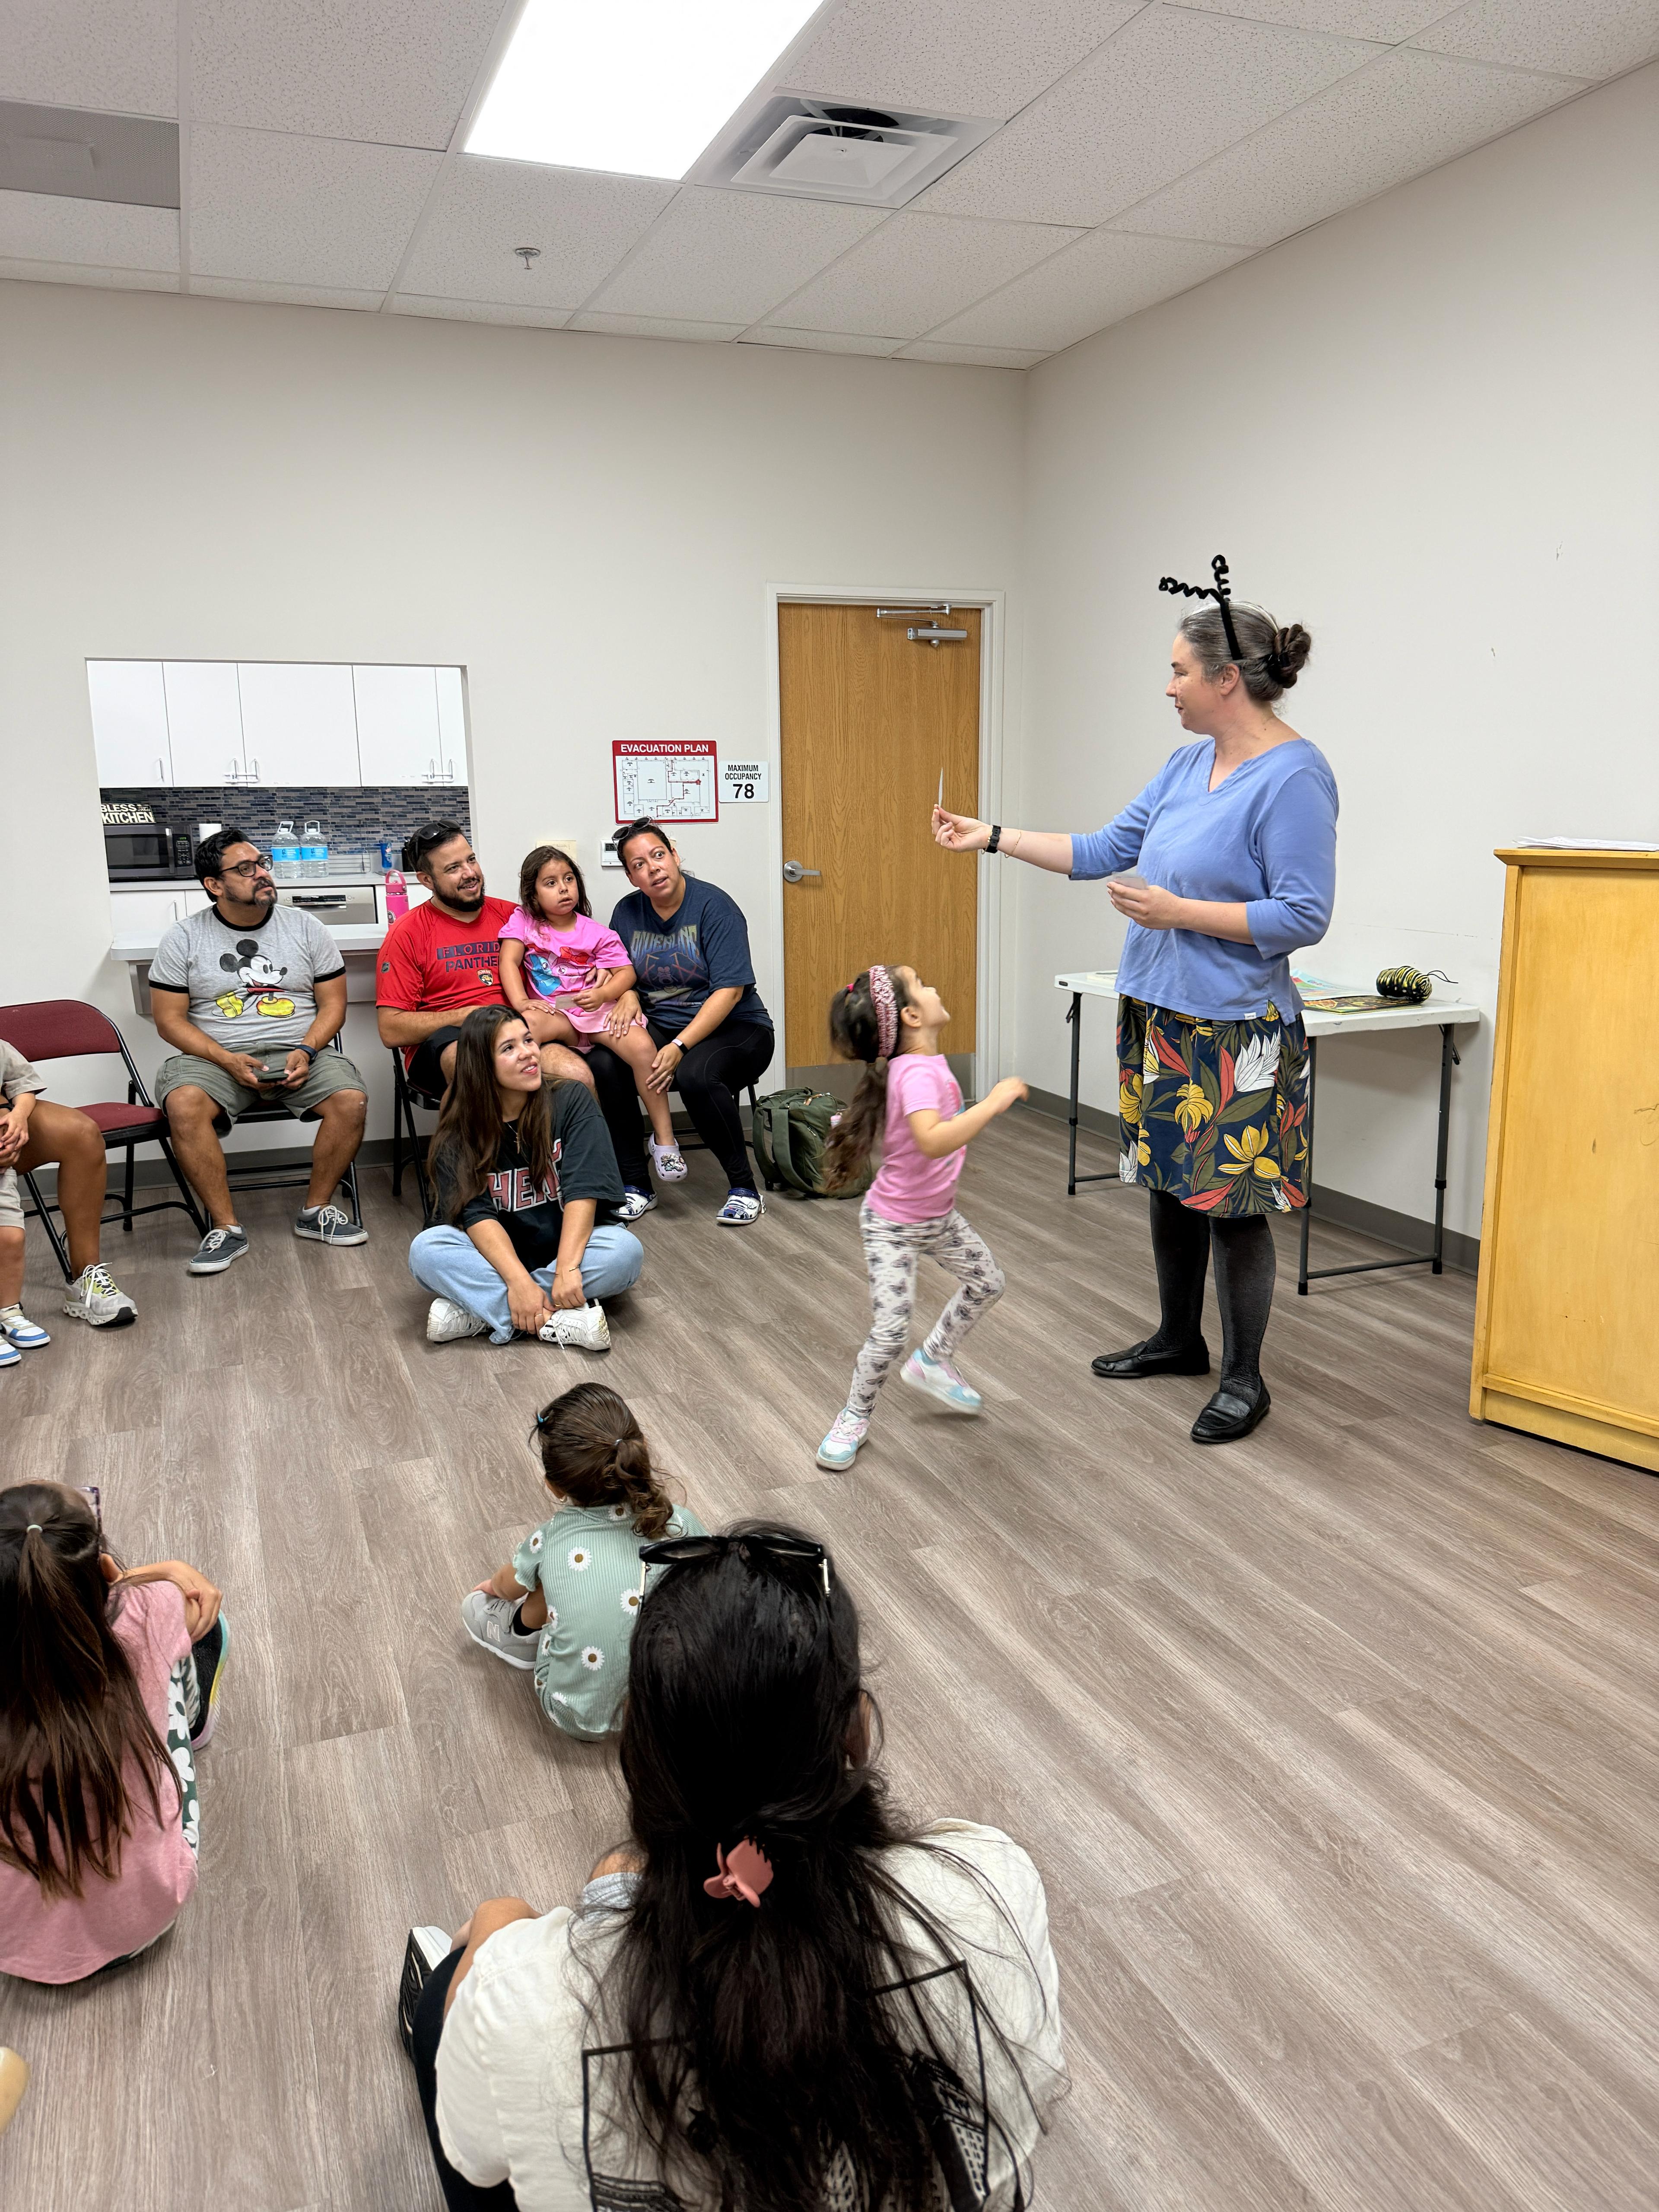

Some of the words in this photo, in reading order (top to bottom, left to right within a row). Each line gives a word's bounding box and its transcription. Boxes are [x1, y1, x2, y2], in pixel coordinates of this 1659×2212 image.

[620, 744, 682, 753] EVACUATION
[684, 744, 709, 753] PLAN
[733, 783, 755, 799] 78
[101, 804, 137, 812] BLESS
[102, 812, 155, 823] KITCHEN
[442, 942, 500, 958] FLORID
[445, 955, 498, 973] PANTHE
[487, 1138, 564, 1212] HEA
[487, 1620, 500, 1642] N
